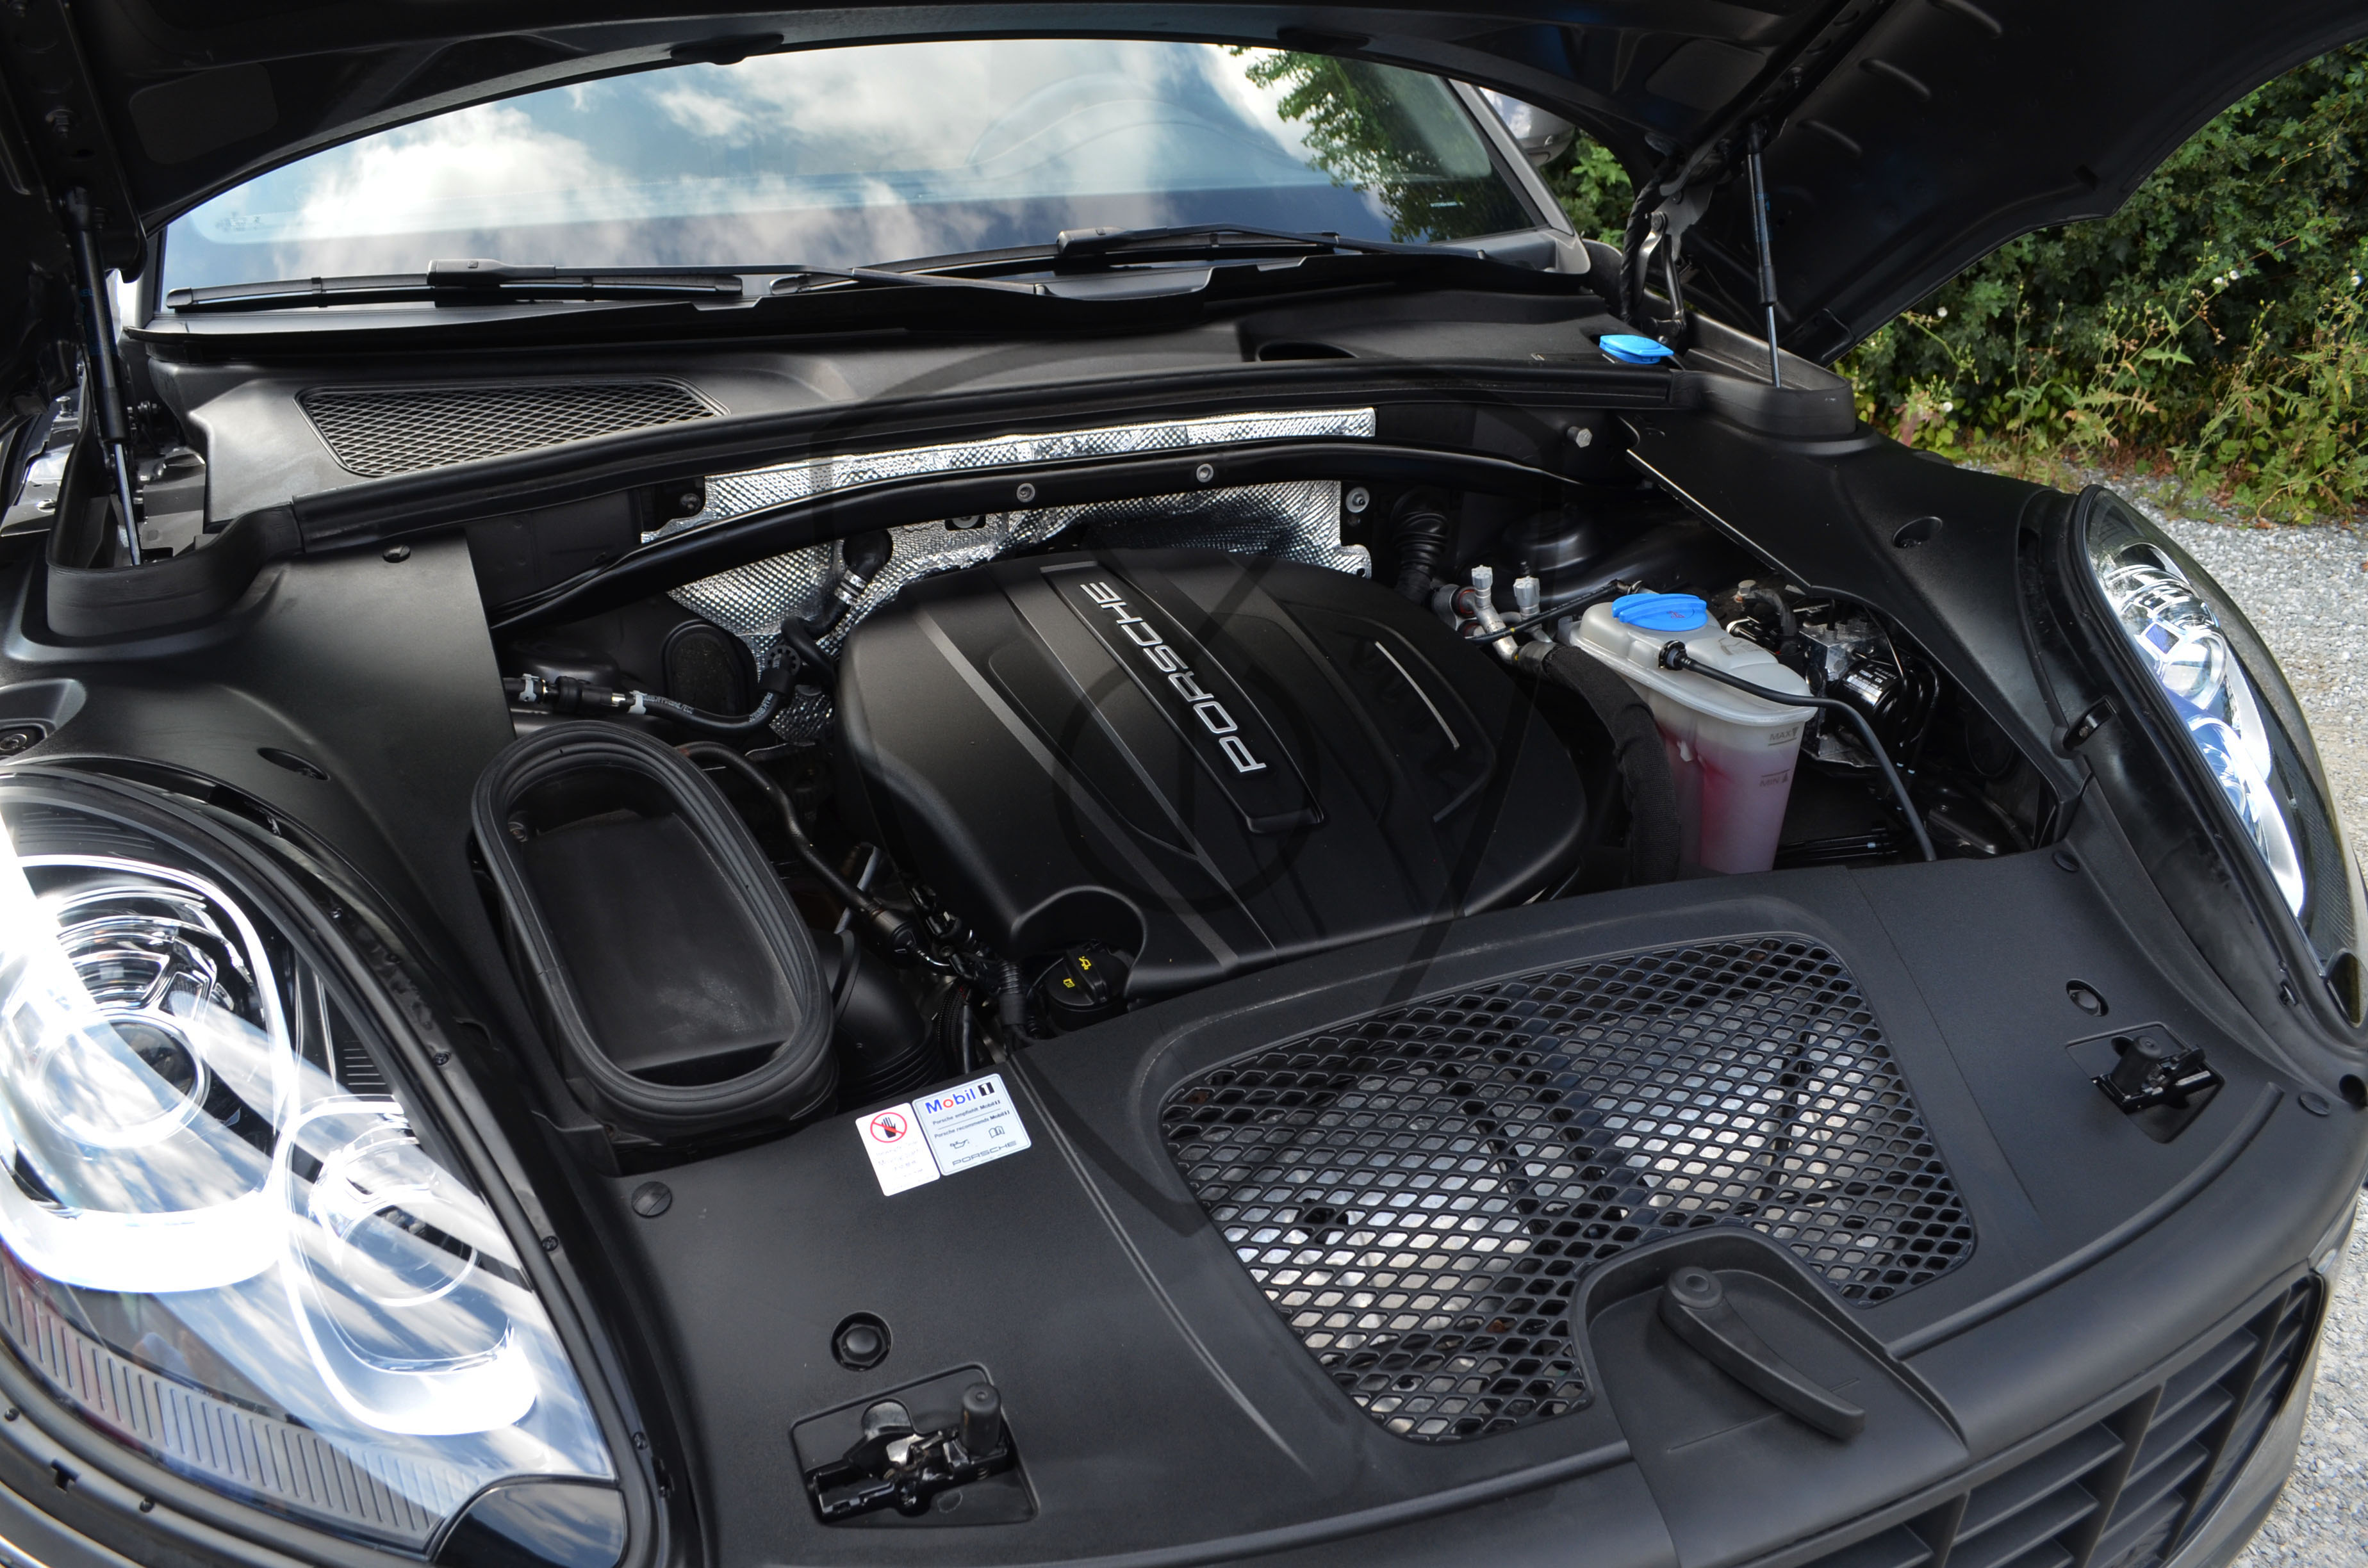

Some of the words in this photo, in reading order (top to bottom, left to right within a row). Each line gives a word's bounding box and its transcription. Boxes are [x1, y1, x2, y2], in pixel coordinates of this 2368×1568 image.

[1080, 581, 1267, 773] PORSCHE
[1769, 731, 1791, 740] MAX
[1759, 776, 1780, 787] MIN
[925, 1088, 976, 1114] Mobil
[979, 1082, 992, 1096] 1
[932, 1116, 954, 1125] Porsche
[934, 1129, 955, 1138] Porsche
[956, 1117, 989, 1132] recommends
[952, 1141, 1017, 1166] PORSCHE
